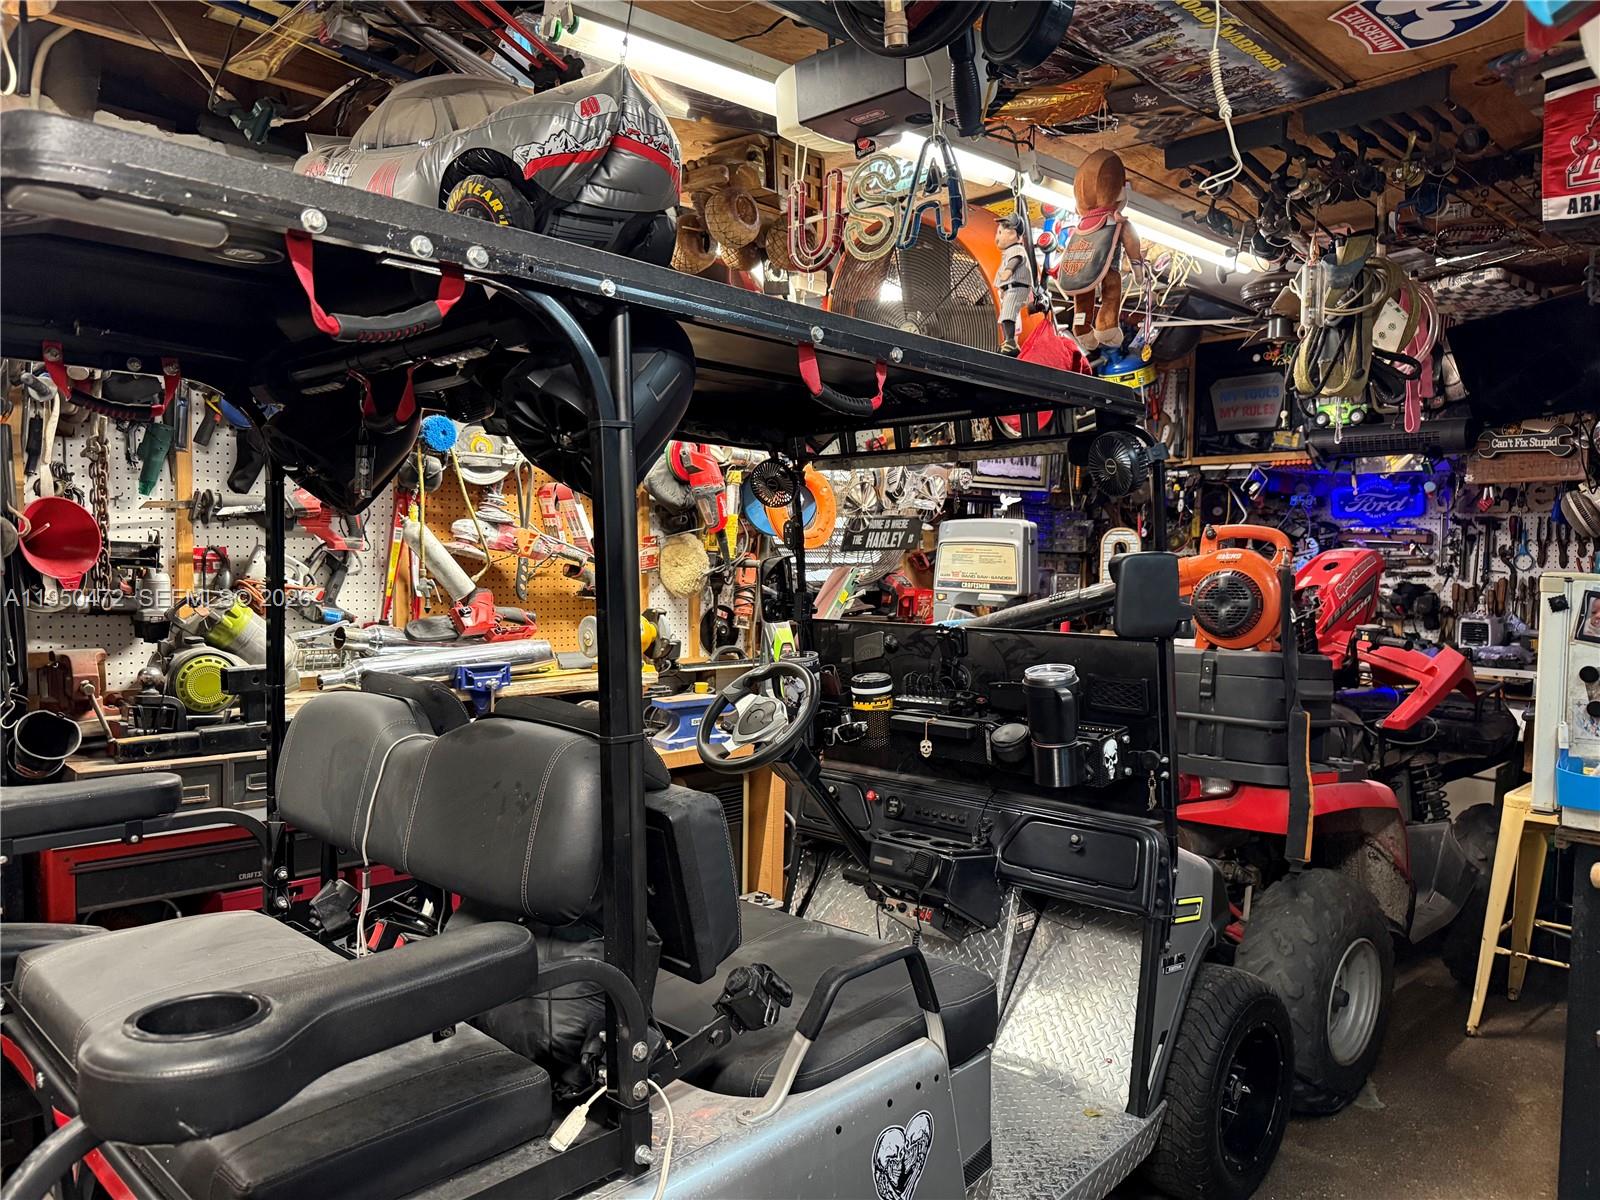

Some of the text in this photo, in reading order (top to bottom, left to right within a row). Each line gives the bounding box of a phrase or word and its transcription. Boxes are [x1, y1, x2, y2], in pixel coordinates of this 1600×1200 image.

[1341, 10, 1397, 51] INTERSTATE
[580, 96, 601, 118] 40
[787, 134, 967, 273] USA
[1242, 385, 1280, 401] TOOLS
[1219, 403, 1276, 419] MY RULES
[1491, 437, 1558, 449] Can't Fix Stupid
[1345, 492, 1409, 513] Ford
[852, 531, 915, 548] THE HARLEY IS
[1347, 594, 1372, 621] 400
